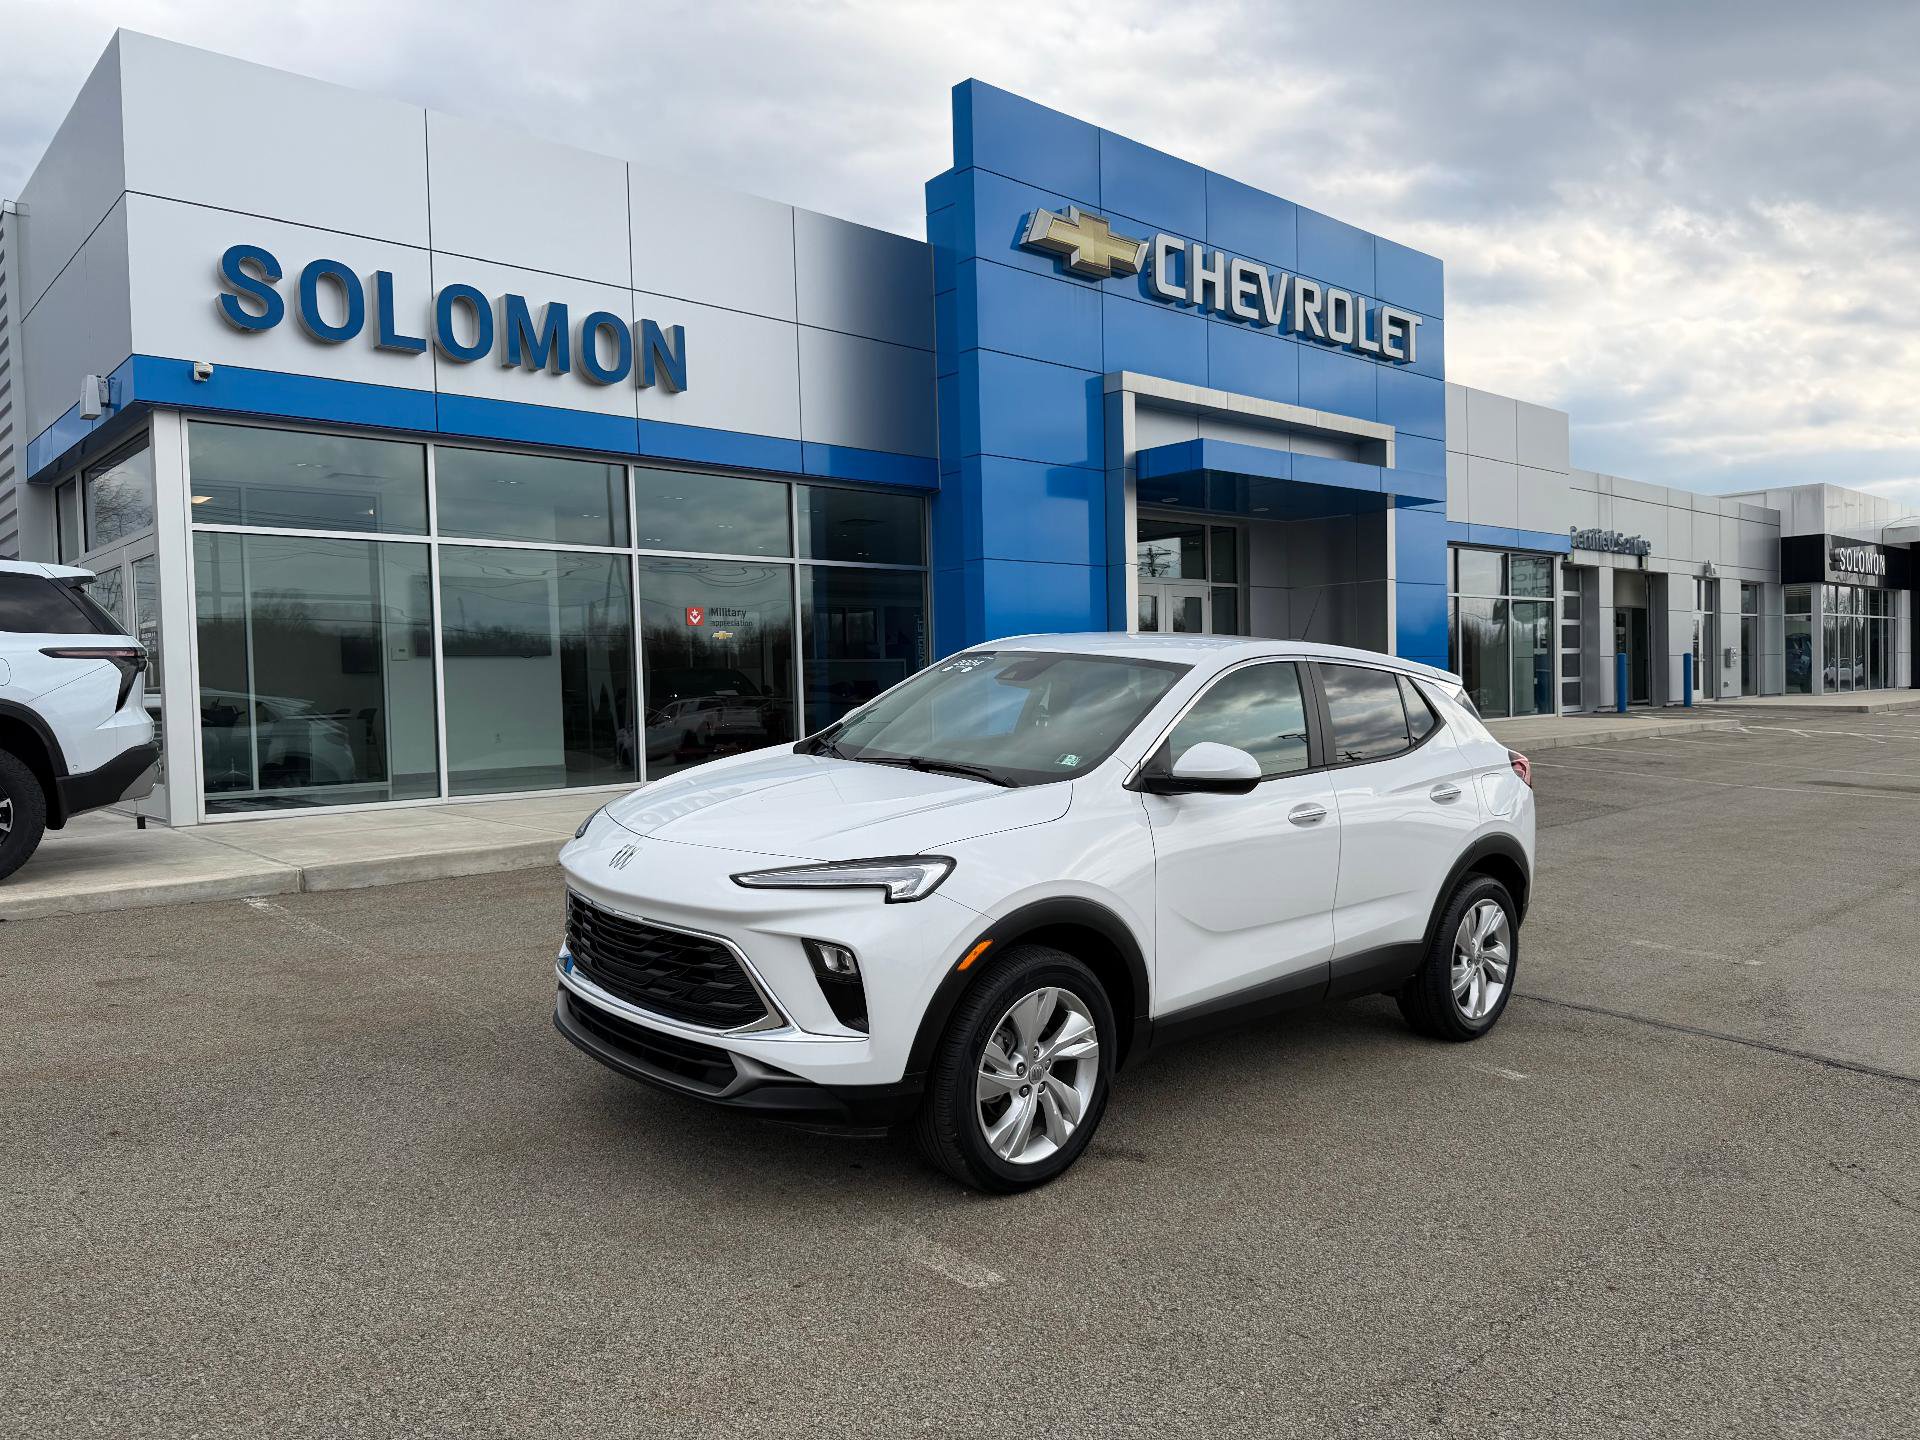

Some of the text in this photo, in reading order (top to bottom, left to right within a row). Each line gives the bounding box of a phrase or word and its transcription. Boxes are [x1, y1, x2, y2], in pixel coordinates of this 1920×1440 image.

[1151, 232, 1423, 363] CHEVROLET
[215, 244, 688, 393] SOLOMON
[1569, 525, 1614, 551] Certified
[1839, 547, 1886, 576] SOLOMON
[710, 607, 747, 619] Military
